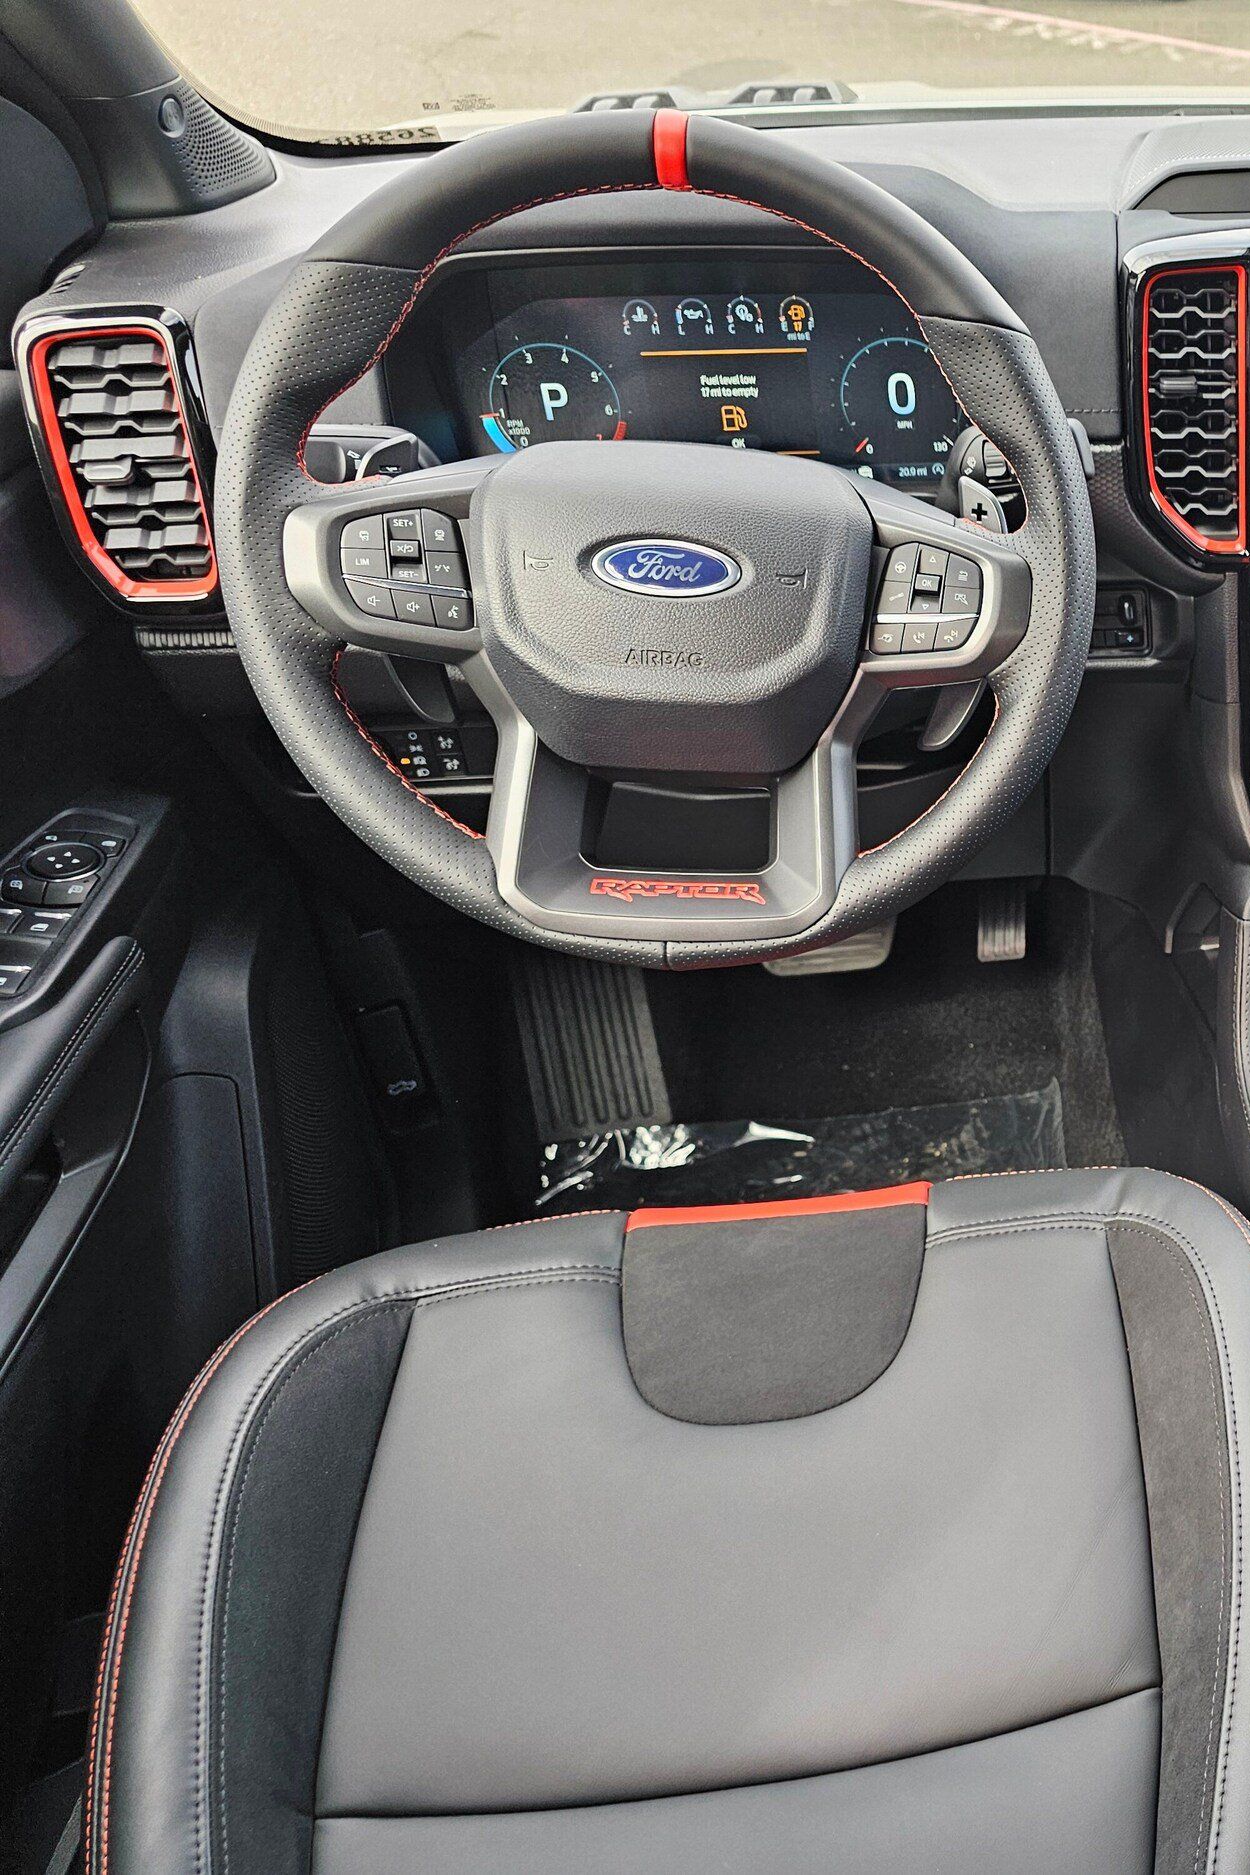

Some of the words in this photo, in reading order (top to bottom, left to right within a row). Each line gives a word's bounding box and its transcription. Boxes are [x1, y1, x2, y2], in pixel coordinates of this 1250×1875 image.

[525, 353, 533, 364] 3
[561, 353, 569, 363] 4
[500, 374, 508, 386] 2
[700, 374, 719, 385] Fuel
[719, 374, 740, 385] level
[740, 374, 756, 385] low
[721, 387, 732, 397] to
[732, 387, 759, 398] empty
[888, 372, 916, 415] 0
[540, 382, 568, 420] P
[507, 419, 524, 427] RPM
[897, 420, 913, 429] MPH
[731, 437, 746, 448] OK
[933, 441, 948, 452] 130
[865, 443, 874, 454] 0
[899, 467, 916, 477] 20.9
[917, 467, 927, 476] mi
[355, 558, 369, 566] LIM
[628, 545, 700, 583] Ford
[921, 579, 932, 587] OK
[625, 648, 704, 668] AIRBAG
[590, 878, 766, 905] RAPTOR
